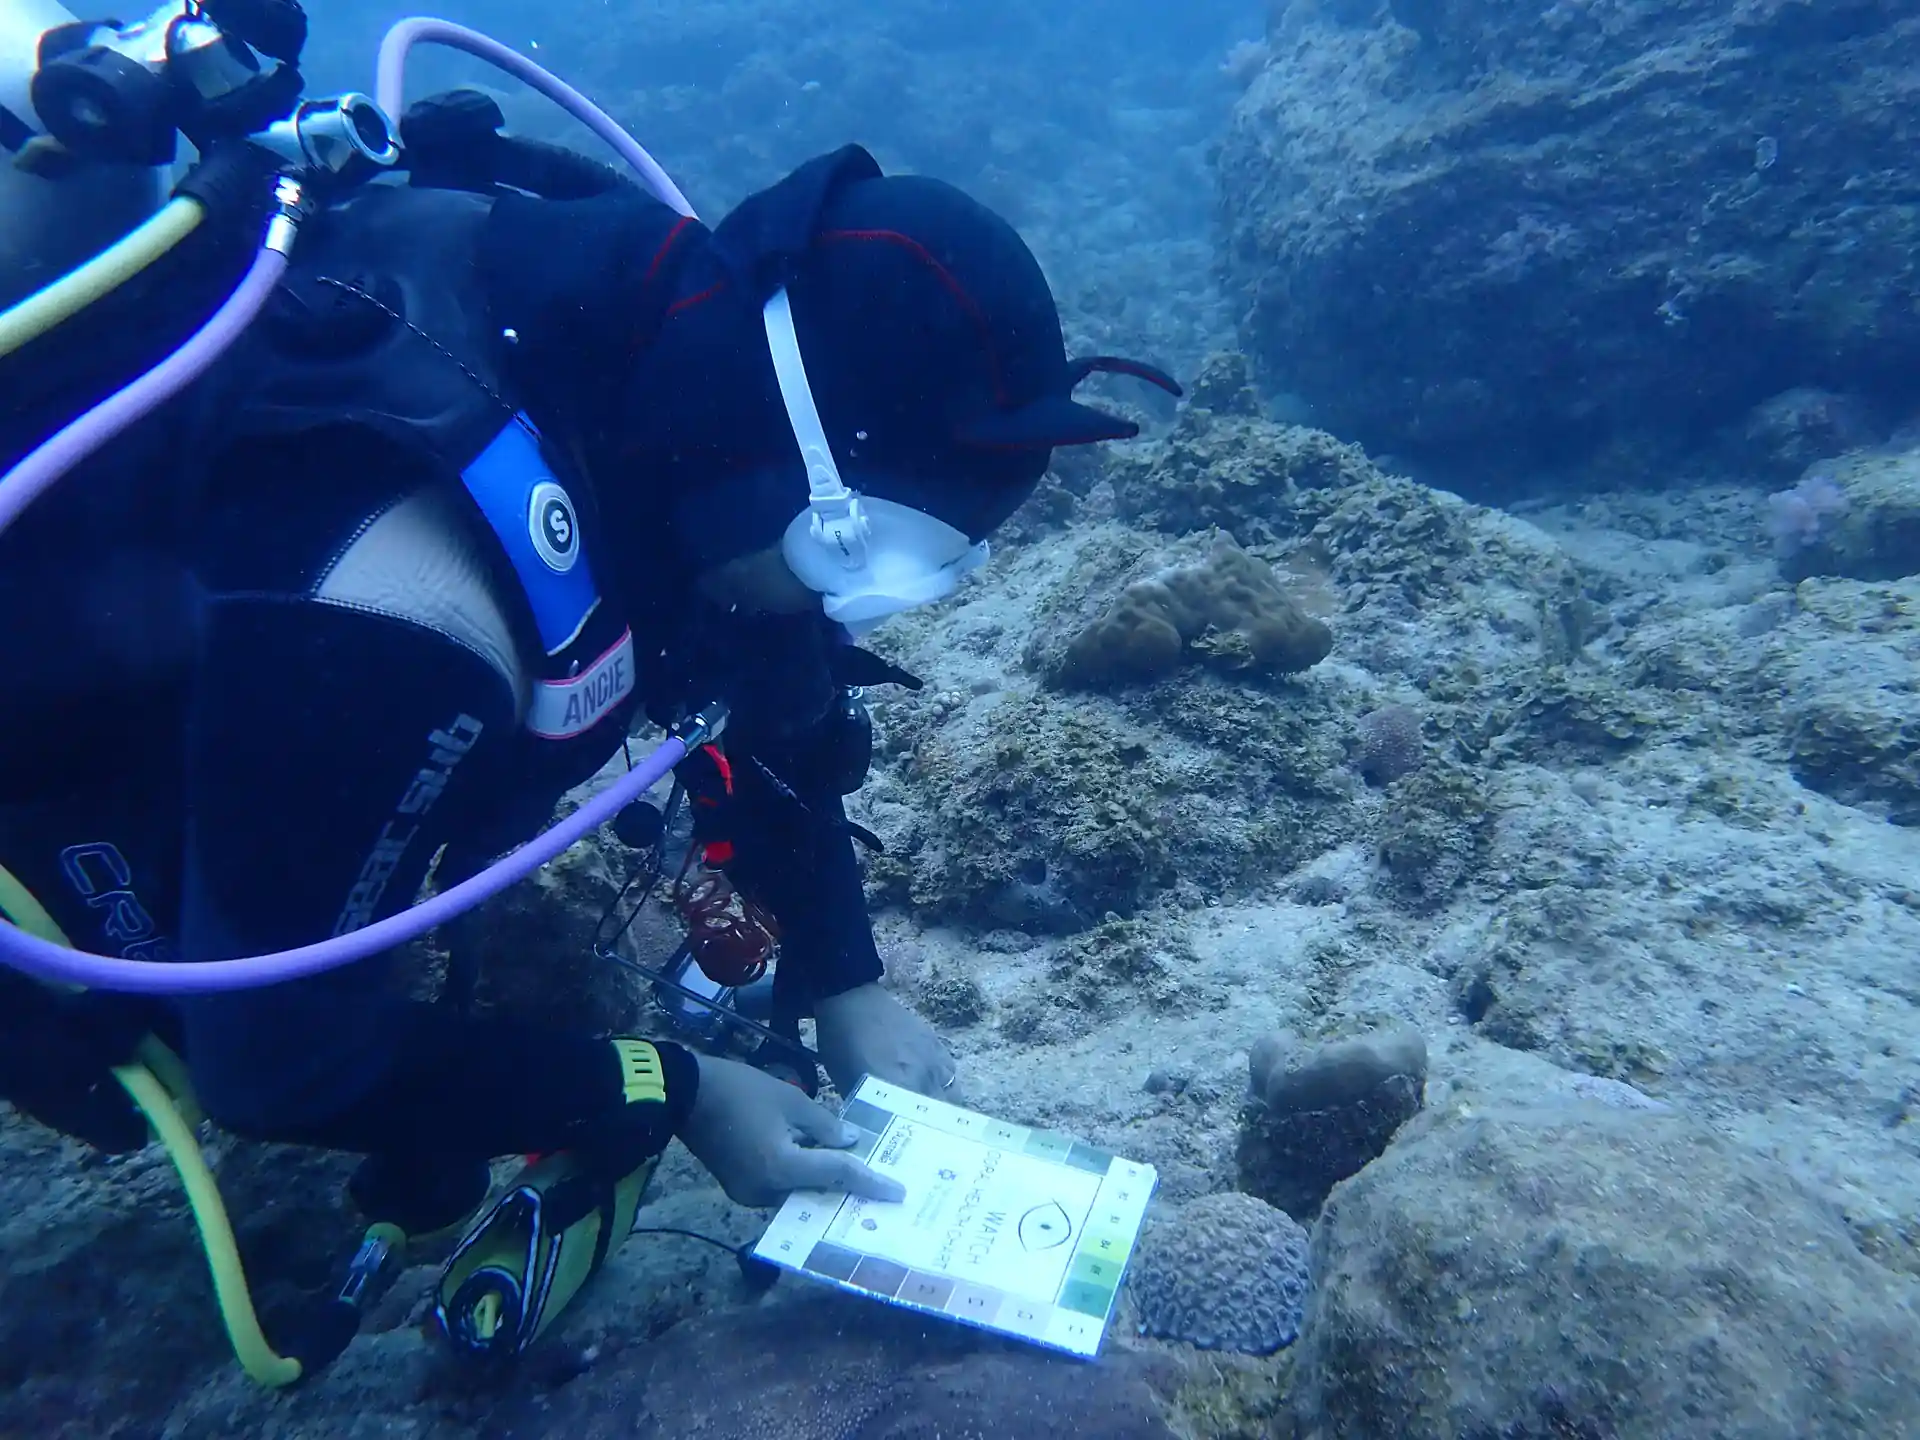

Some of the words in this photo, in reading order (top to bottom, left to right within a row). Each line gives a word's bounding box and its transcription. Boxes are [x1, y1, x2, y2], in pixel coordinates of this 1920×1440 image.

[550, 509, 570, 543] S
[562, 656, 626, 728] ANGIE
[972, 1150, 1001, 1185] CORAL
[956, 1189, 983, 1229] HEALTH
[931, 1229, 963, 1270] CHART
[966, 1211, 1007, 1265] WATCH
[1099, 1238, 1111, 1250] B4
